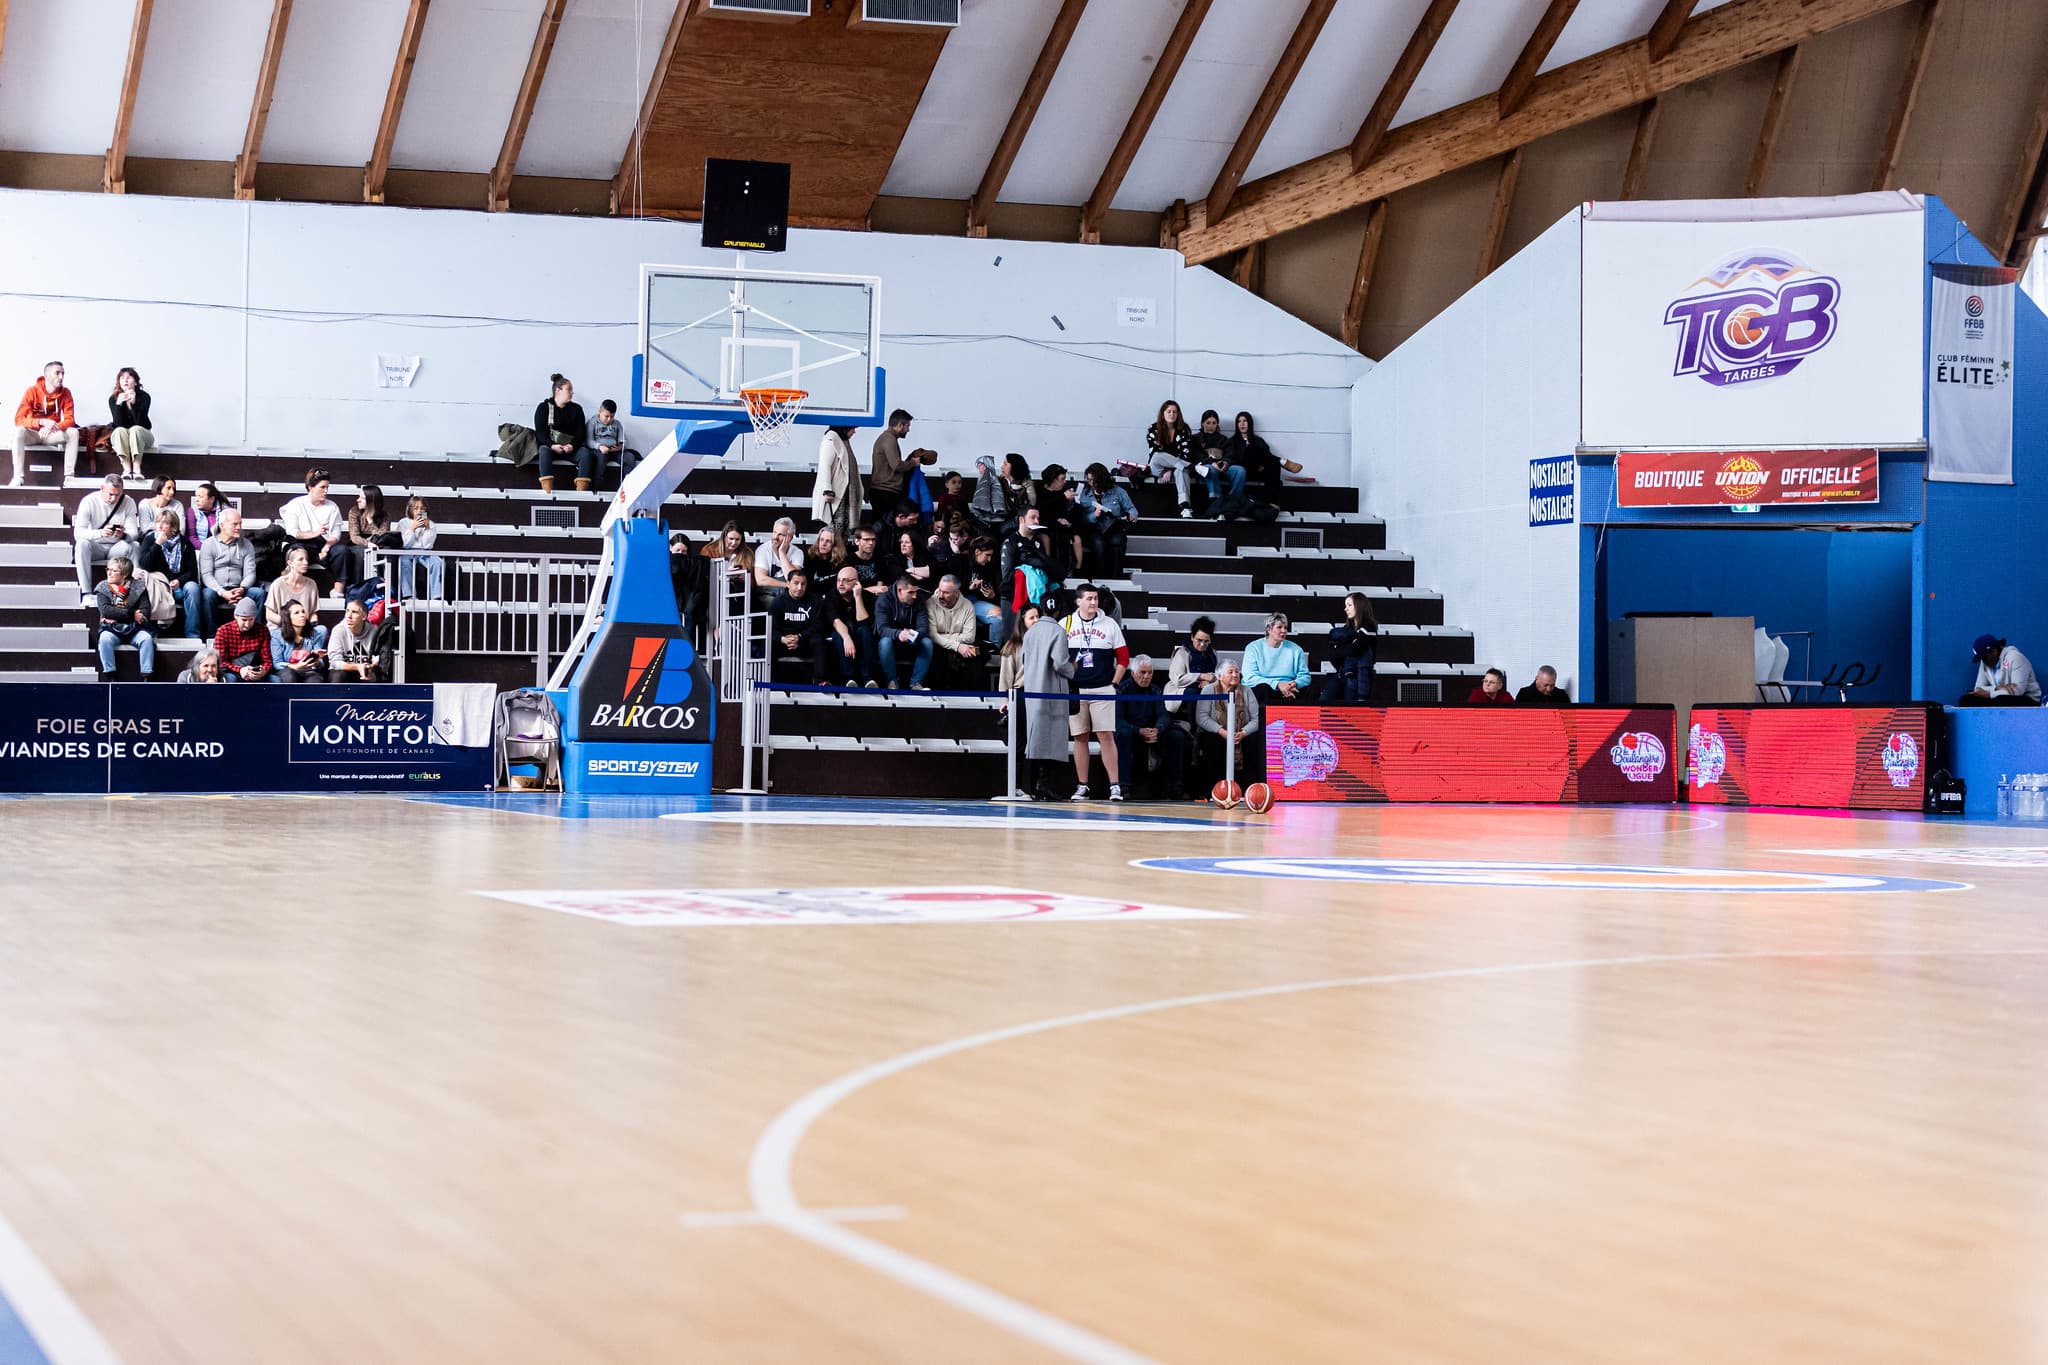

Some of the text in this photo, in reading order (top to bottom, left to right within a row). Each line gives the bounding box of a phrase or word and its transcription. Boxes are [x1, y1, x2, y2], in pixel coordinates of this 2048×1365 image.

[1664, 276, 1841, 376] TGB
[1964, 319, 1985, 329] FFBB
[1937, 354, 1994, 364] CLUB FÉMININ
[1724, 365, 1776, 383] TARBES
[1937, 362, 1994, 385] ÉLITE
[1530, 460, 1574, 490] NOSTALGIE
[1634, 466, 1862, 490] BOUTIQUE UNION OFFICIELLE
[1530, 494, 1573, 524] NOSTALGIE
[784, 612, 806, 621] PUMA
[335, 703, 427, 722] Maison
[590, 703, 700, 729] BARCOS
[36, 718, 184, 735] FOIE GRAS ET
[97, 742, 127, 758] DE
[132, 742, 224, 758] CANARD
[1621, 764, 1659, 773] WONDER
[1628, 772, 1653, 780] LIGUE
